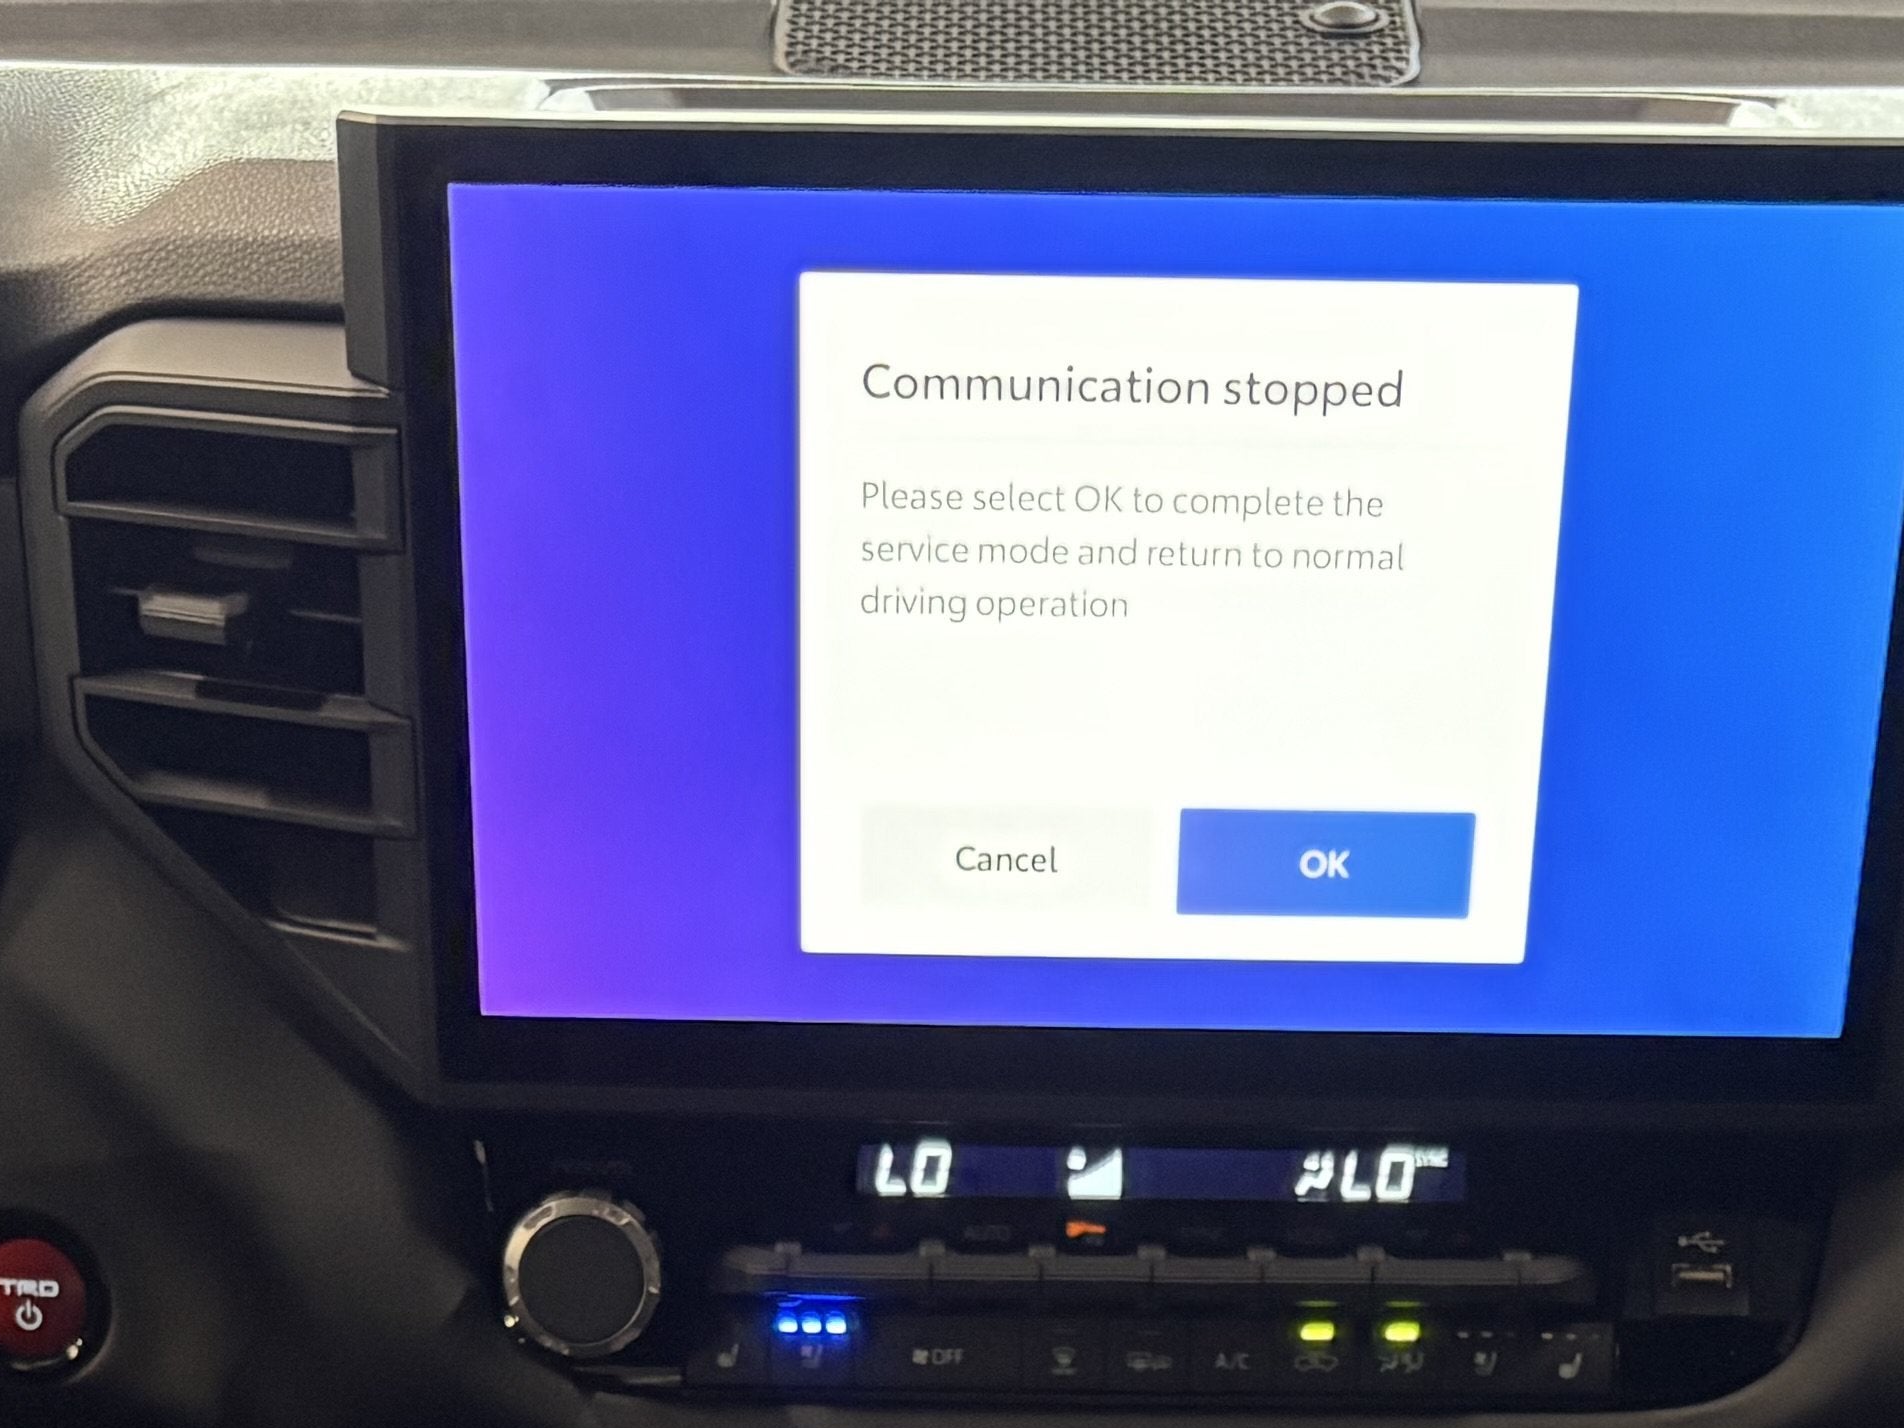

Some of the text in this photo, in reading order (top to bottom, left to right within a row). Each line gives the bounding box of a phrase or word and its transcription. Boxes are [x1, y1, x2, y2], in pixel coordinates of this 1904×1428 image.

[862, 362, 1404, 418] Communication stopped
[861, 479, 1385, 524] Please select OK to complete the
[861, 534, 1405, 572] service mode and return to normal
[860, 584, 1129, 624] driving operation
[955, 845, 1059, 874] Cancel
[1298, 849, 1350, 879] OK
[875, 1138, 953, 1197] LO
[1214, 1350, 1250, 1372] A/C
